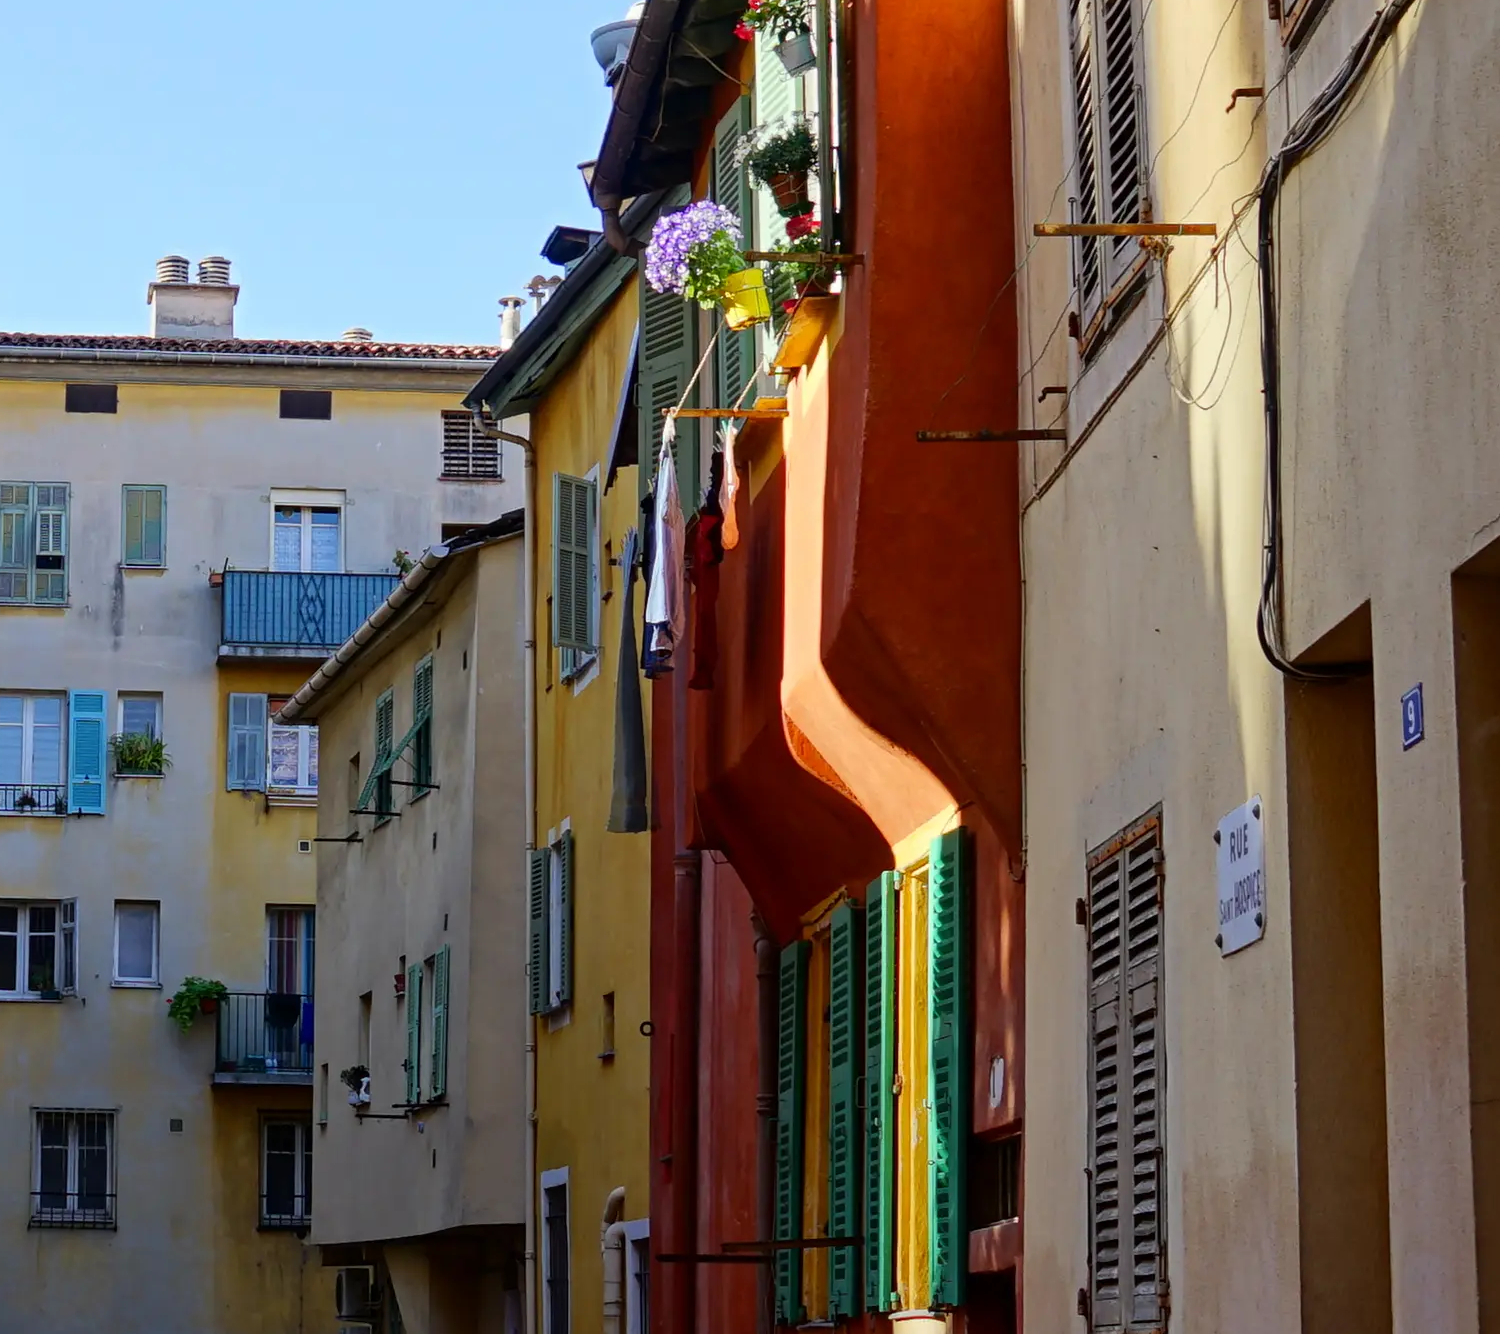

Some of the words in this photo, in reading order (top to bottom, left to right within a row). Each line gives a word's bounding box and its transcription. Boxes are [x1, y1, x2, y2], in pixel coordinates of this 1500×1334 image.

[1407, 699, 1415, 734] 9
[1229, 822, 1249, 863] RUE
[1234, 869, 1262, 919] HOSPICE
